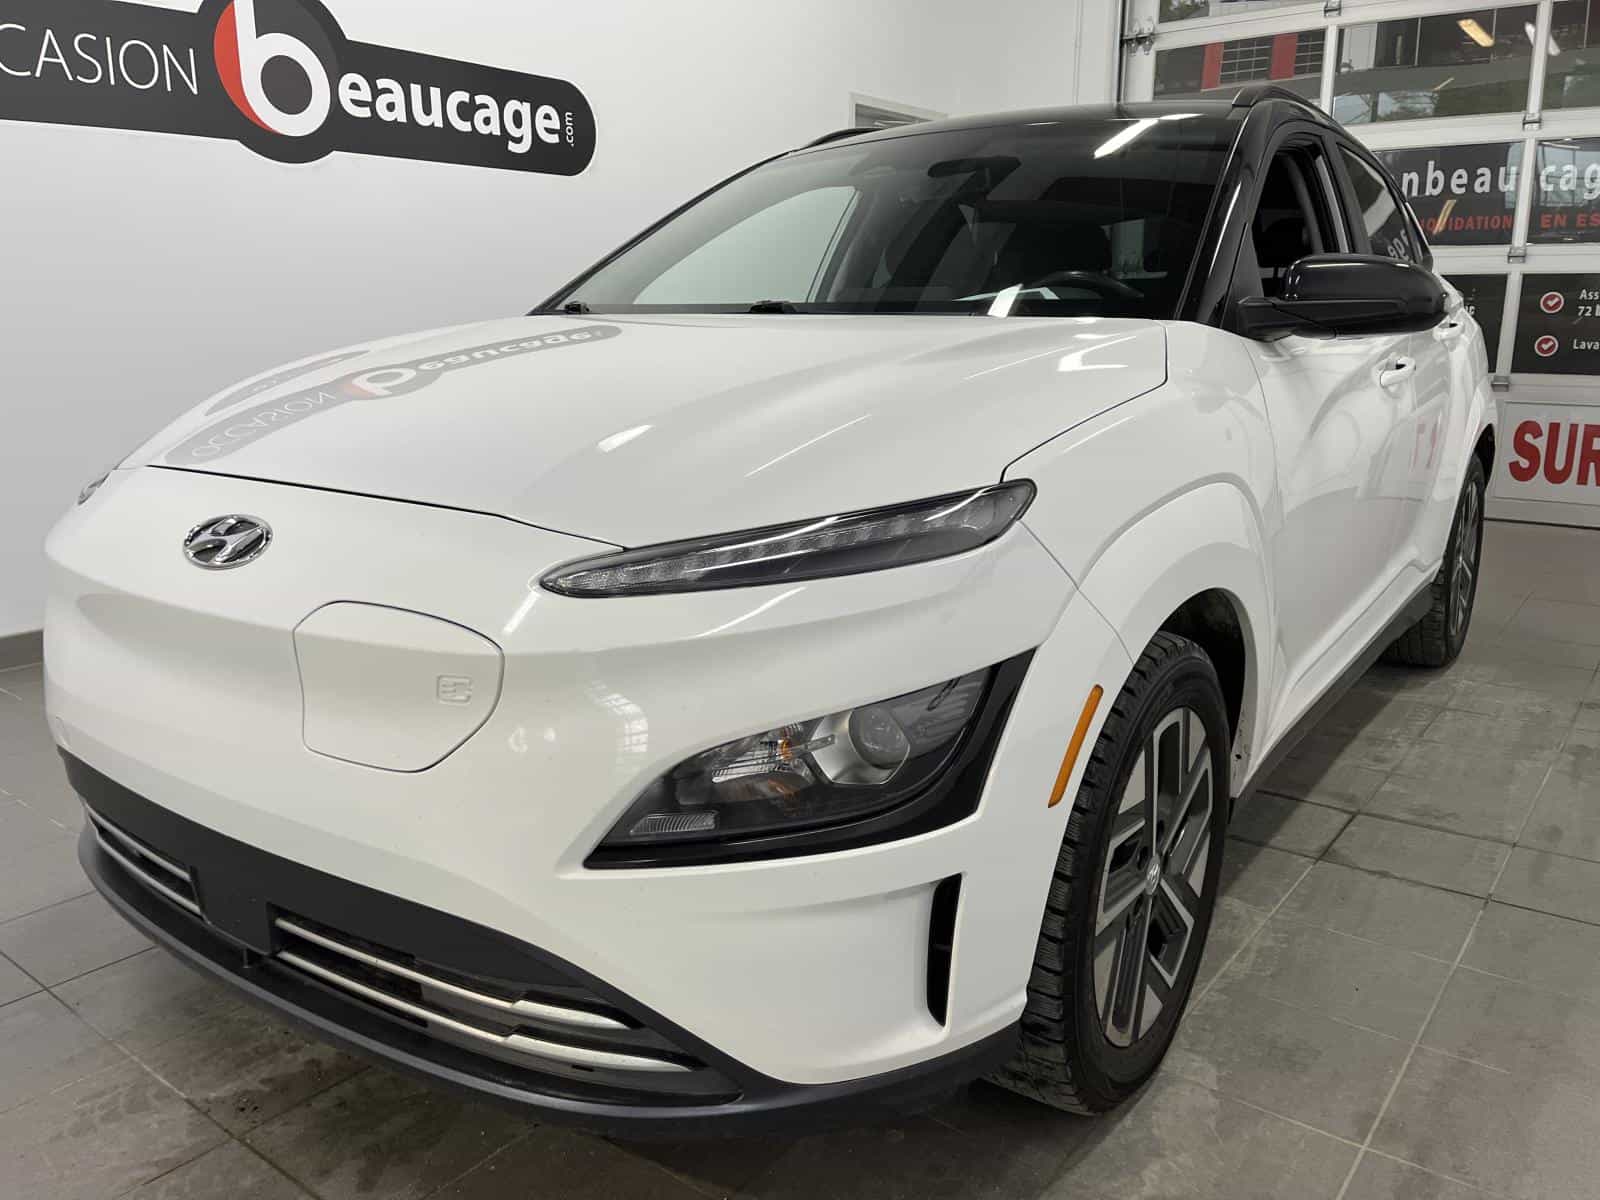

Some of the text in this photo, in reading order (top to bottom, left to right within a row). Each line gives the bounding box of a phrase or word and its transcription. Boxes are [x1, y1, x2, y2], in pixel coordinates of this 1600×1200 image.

[0, 23, 198, 95] CASION
[1540, 213, 1566, 229] EN
[1578, 306, 1592, 317] 72
